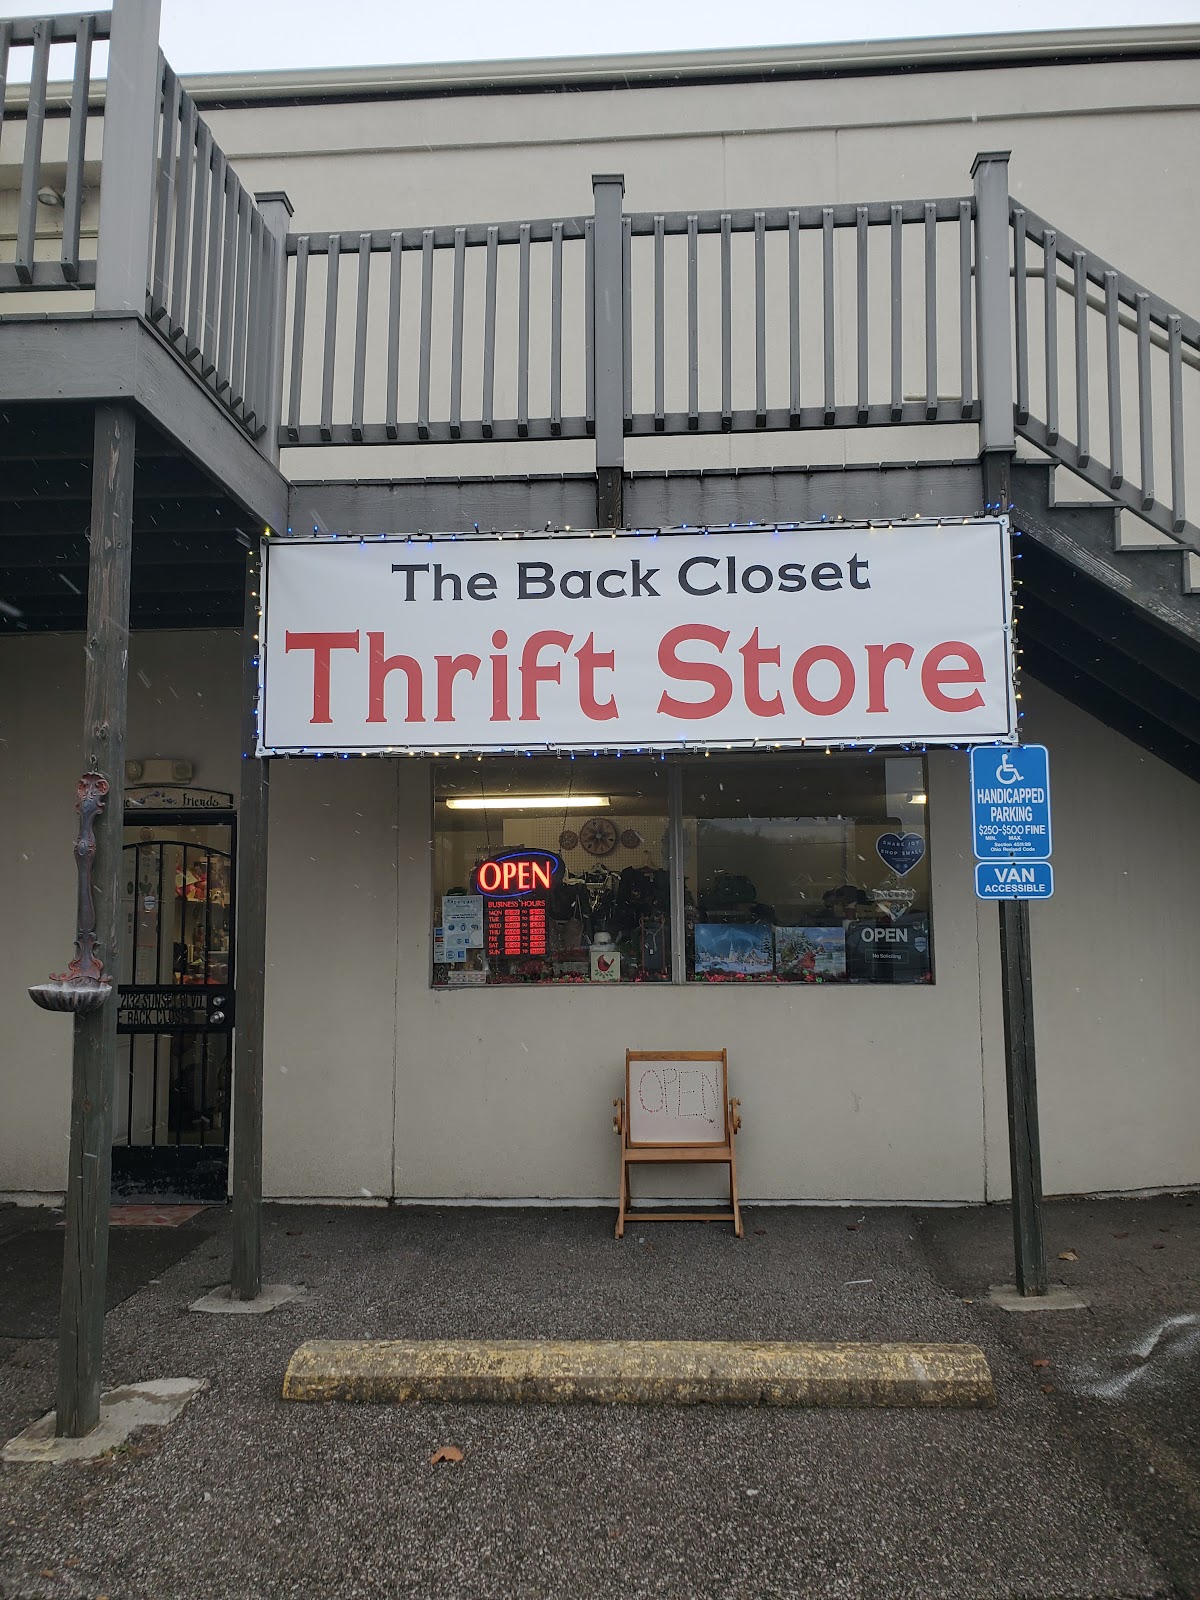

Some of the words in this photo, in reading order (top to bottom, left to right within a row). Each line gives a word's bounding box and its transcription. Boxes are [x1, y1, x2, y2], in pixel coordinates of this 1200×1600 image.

[392, 562, 498, 601] The
[517, 559, 660, 600] Back
[677, 553, 872, 597] Closet
[285, 628, 620, 724] Thrift
[656, 623, 988, 720] Store
[183, 793, 219, 807] friends
[977, 788, 1044, 804] HANDICAPPED
[990, 806, 1033, 822] PARKING
[979, 823, 1024, 836] $250-$500
[1025, 824, 1046, 835] FINE
[901, 848, 923, 856] SMALL
[478, 860, 551, 891] OPEN
[994, 867, 1035, 883] VAN
[984, 883, 1046, 893] ACCESSIBLE
[520, 899, 546, 907] HOURS
[861, 927, 908, 943] OPEN
[120, 994, 140, 1008] 2132
[638, 1067, 720, 1123] OPEN
